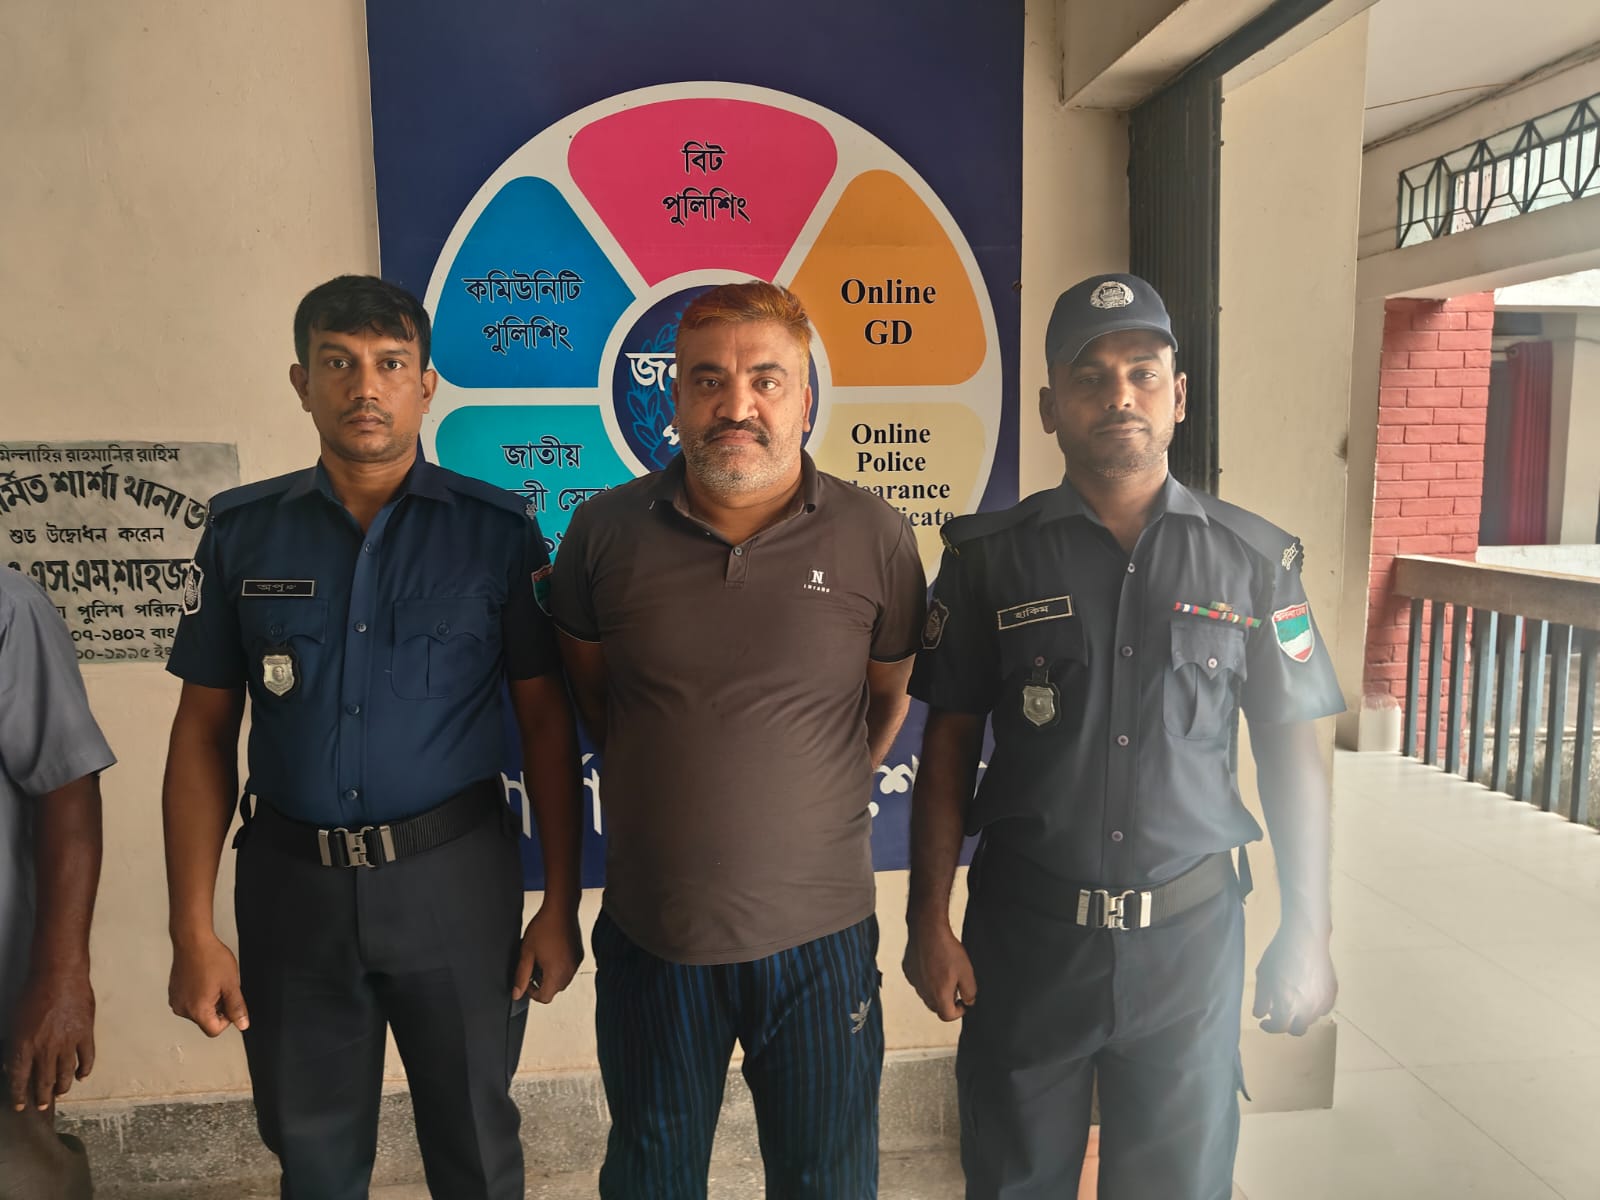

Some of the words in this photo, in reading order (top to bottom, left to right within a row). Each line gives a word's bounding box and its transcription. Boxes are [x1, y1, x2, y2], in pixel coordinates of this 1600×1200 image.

[681, 140, 727, 174] বিট
[662, 187, 751, 227] পুলিশিং
[461, 269, 584, 304] কমিউনিটি
[841, 279, 936, 304] Online
[482, 315, 573, 355] পুলিশিং
[864, 320, 913, 345] GD
[851, 423, 931, 445] Online
[136, 443, 180, 462] রাহিম
[501, 435, 584, 469] জাতীয়
[856, 451, 926, 472] Police
[123, 475, 187, 520] থানা
[849, 480, 950, 499] arance
[9, 529, 37, 544] শুভ
[118, 528, 164, 543] করেন
[78, 600, 124, 625] পুলিশ
[134, 599, 184, 617] পরিদ
